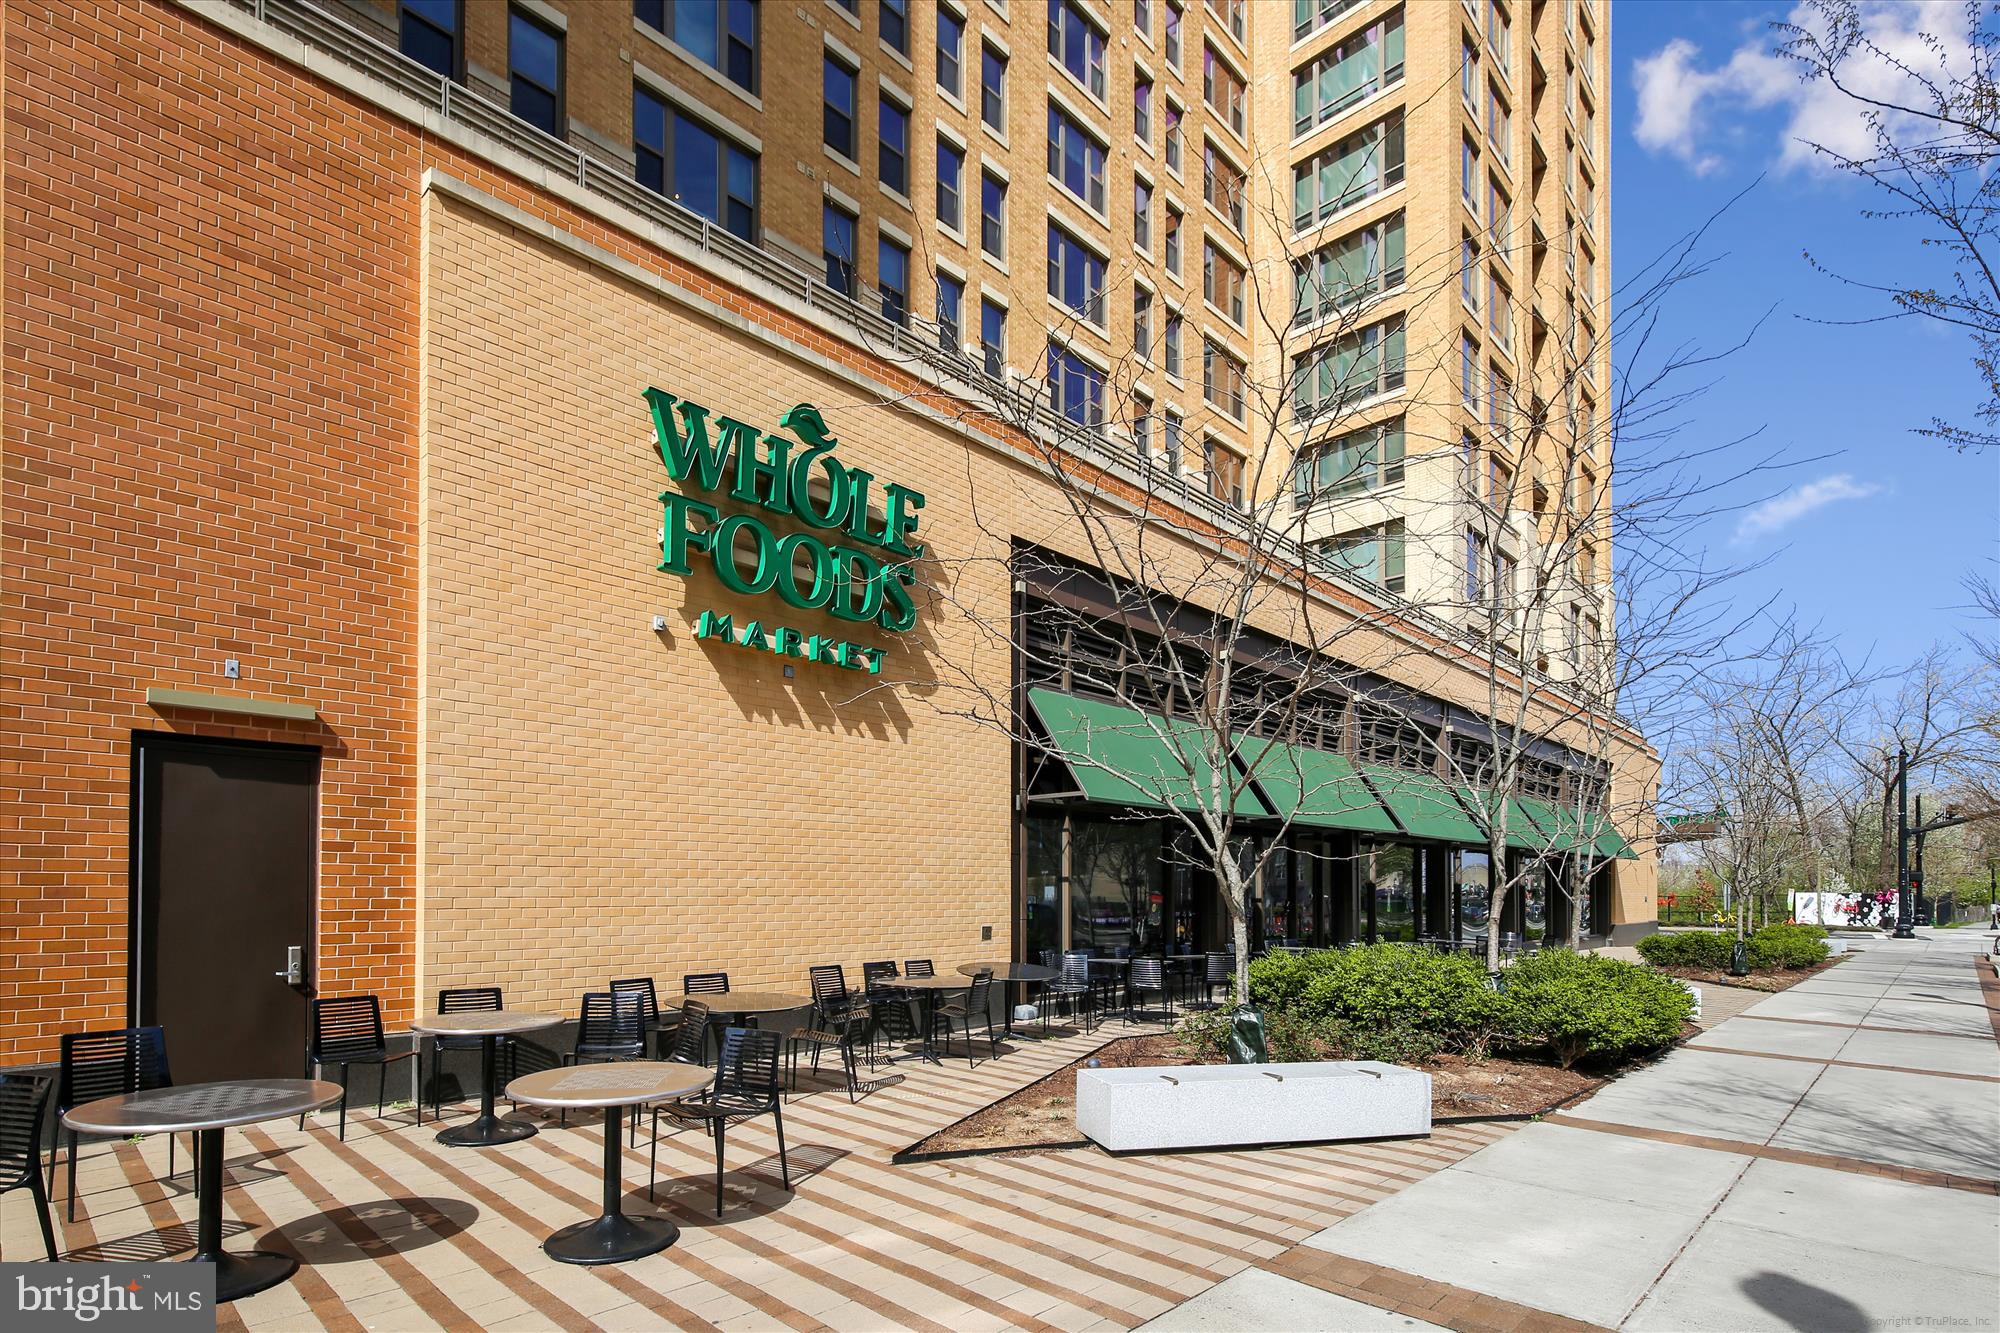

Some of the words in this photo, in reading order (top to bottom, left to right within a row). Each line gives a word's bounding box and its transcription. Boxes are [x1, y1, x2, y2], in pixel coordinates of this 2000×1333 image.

[642, 386, 926, 558] WHOLE
[656, 491, 918, 633] FOODS
[698, 609, 888, 675] MARKET
